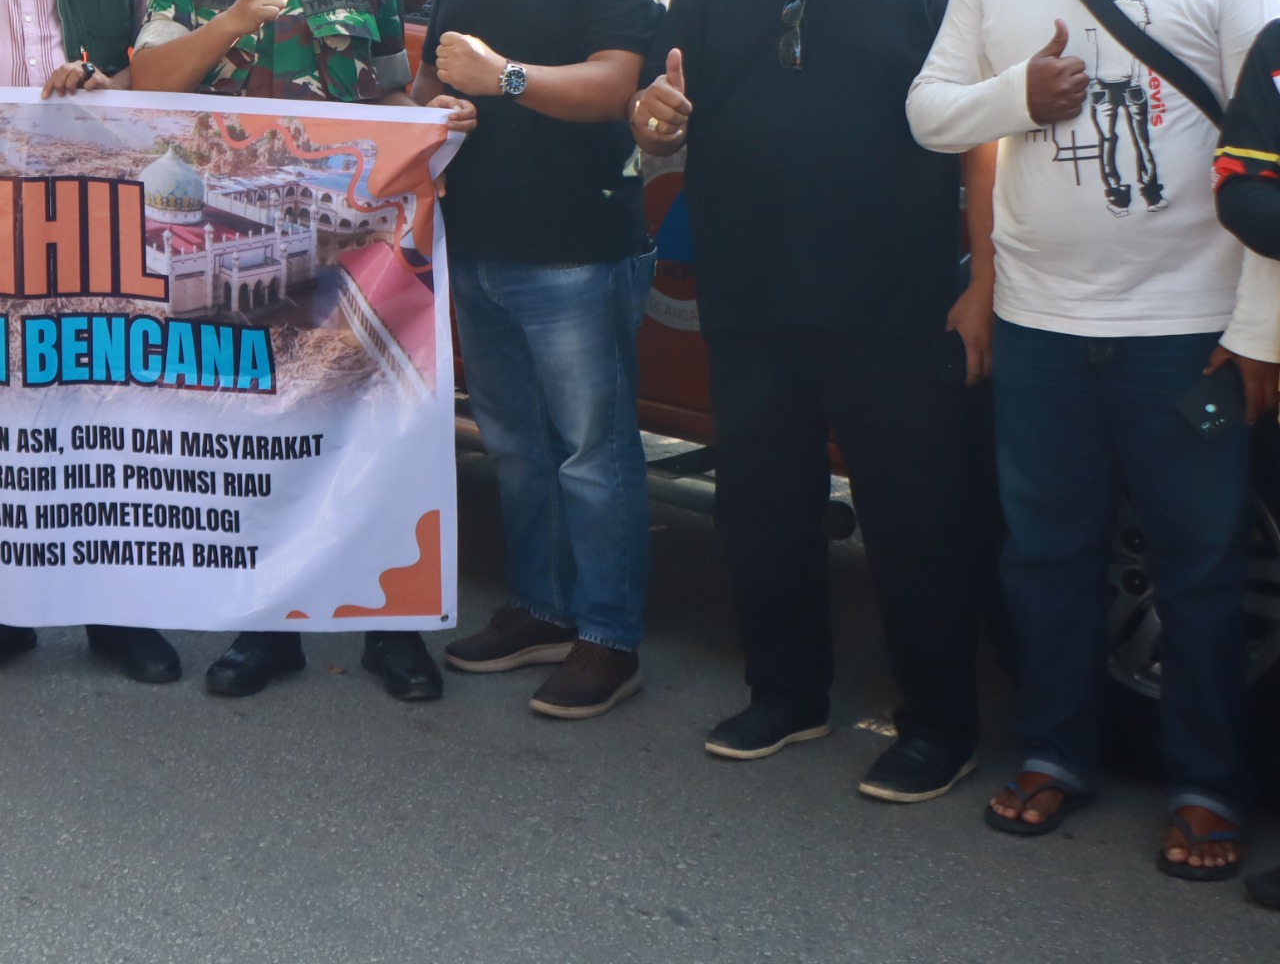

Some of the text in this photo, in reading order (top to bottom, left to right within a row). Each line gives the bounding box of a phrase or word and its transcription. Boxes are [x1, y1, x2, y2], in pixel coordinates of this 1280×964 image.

[21, 312, 276, 395] BENCANA
[16, 427, 64, 455] ASN,
[71, 425, 125, 451] GURU
[131, 428, 173, 455] DAN
[180, 431, 324, 461] MASYARAKAT
[63, 463, 116, 490] HILIR
[122, 464, 217, 495] PROVINSI
[223, 472, 272, 498] RIAU
[35, 501, 241, 534] HIDROMETEOROLOGI
[72, 540, 185, 567] SUMATERA
[192, 543, 259, 570] BARAT
